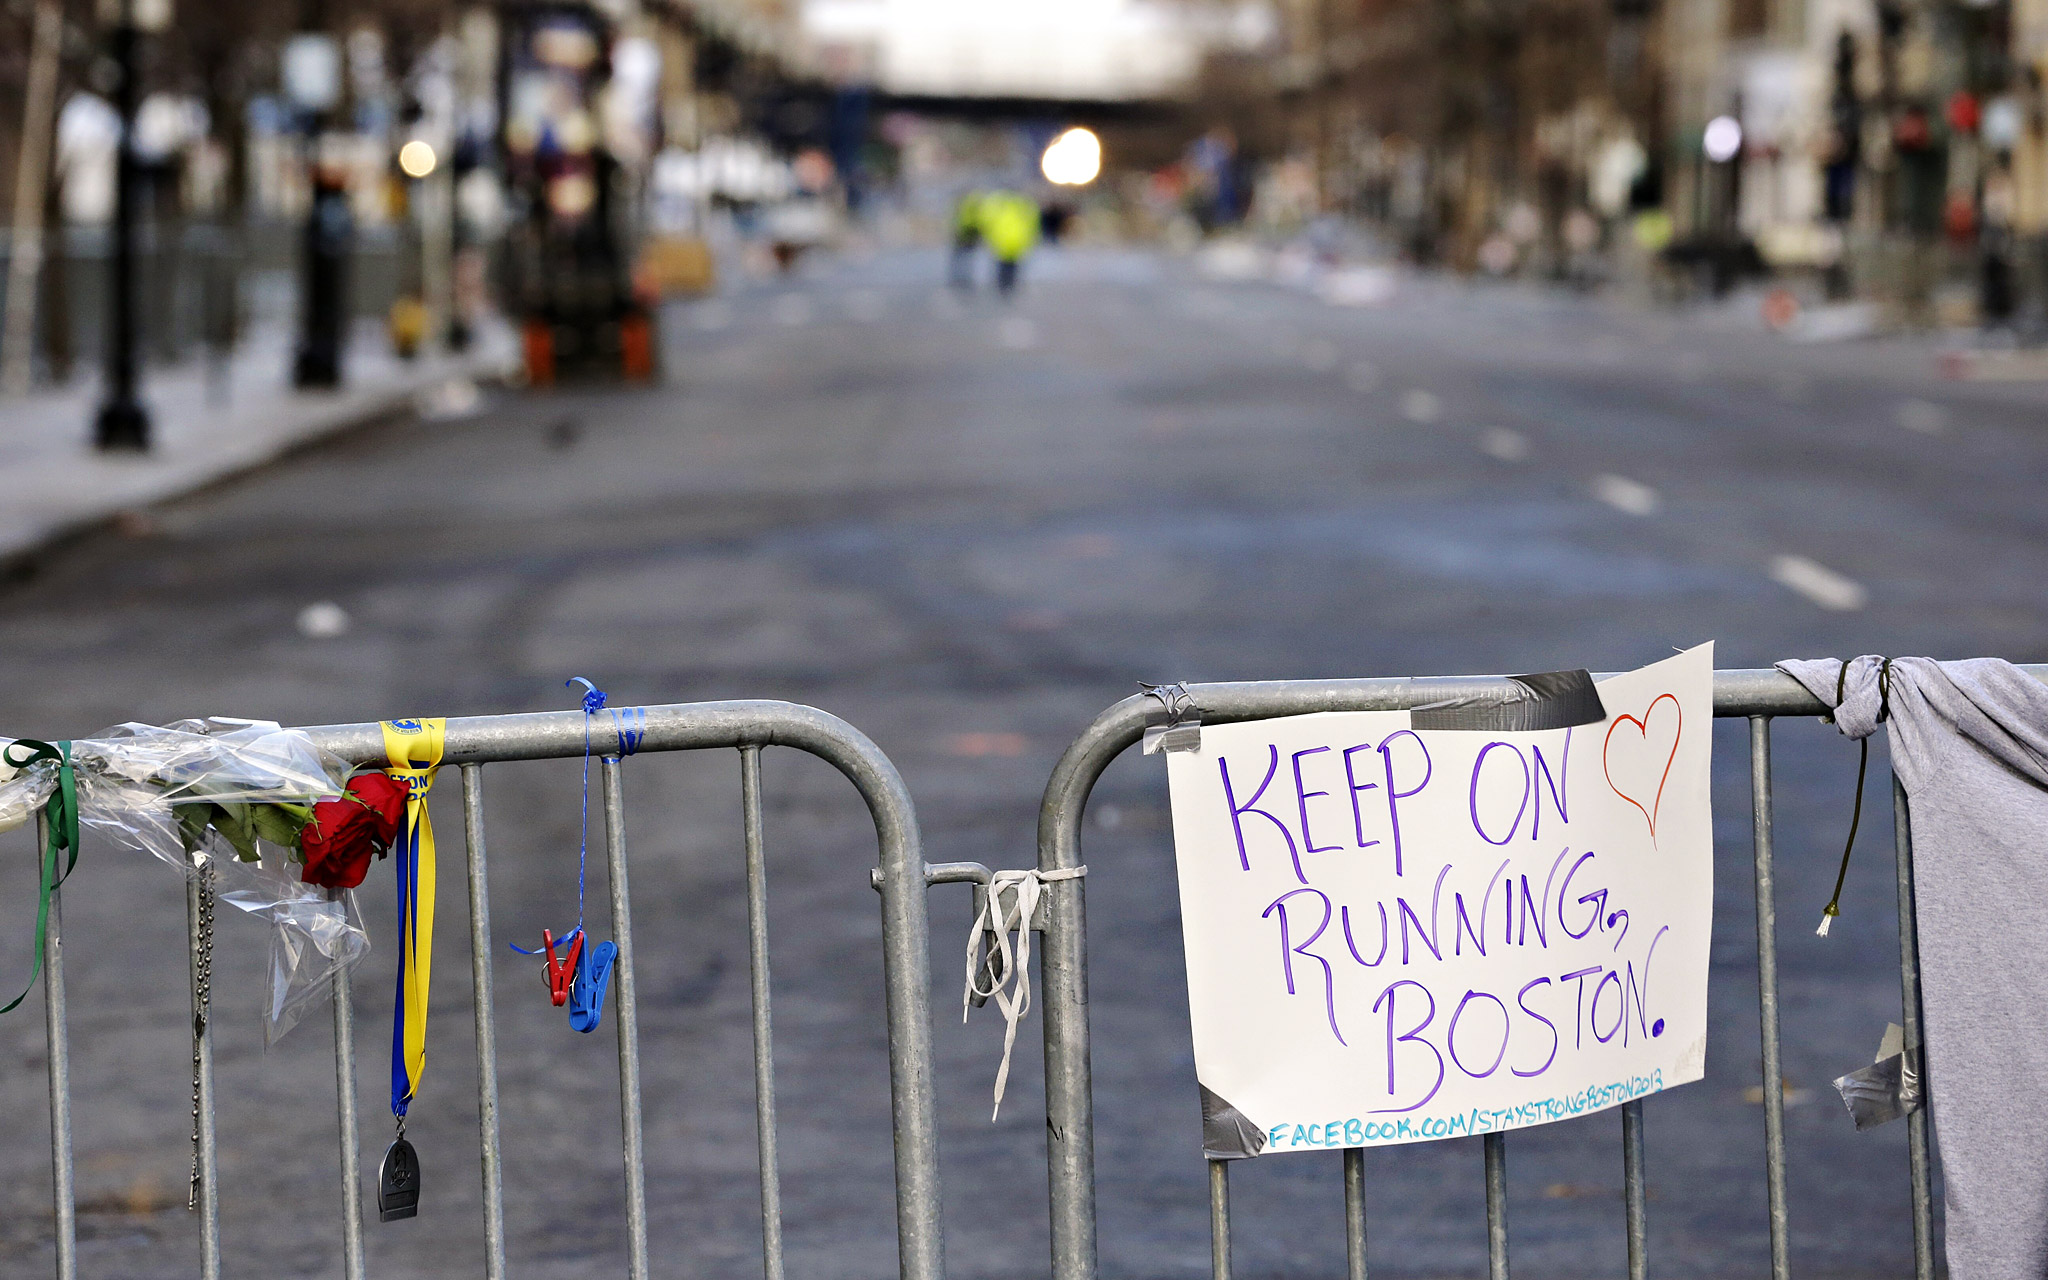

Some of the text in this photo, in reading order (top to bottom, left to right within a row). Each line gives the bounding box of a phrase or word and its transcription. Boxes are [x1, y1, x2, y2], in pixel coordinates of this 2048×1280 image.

[1218, 727, 1572, 884] KEEP ON
[1262, 848, 1629, 1047] RUNNING,
[1368, 926, 1669, 1114] BOSTON.
[1269, 1068, 1664, 1149] FACEBOOK.COM/STAYSTRONGBOSTON2013
